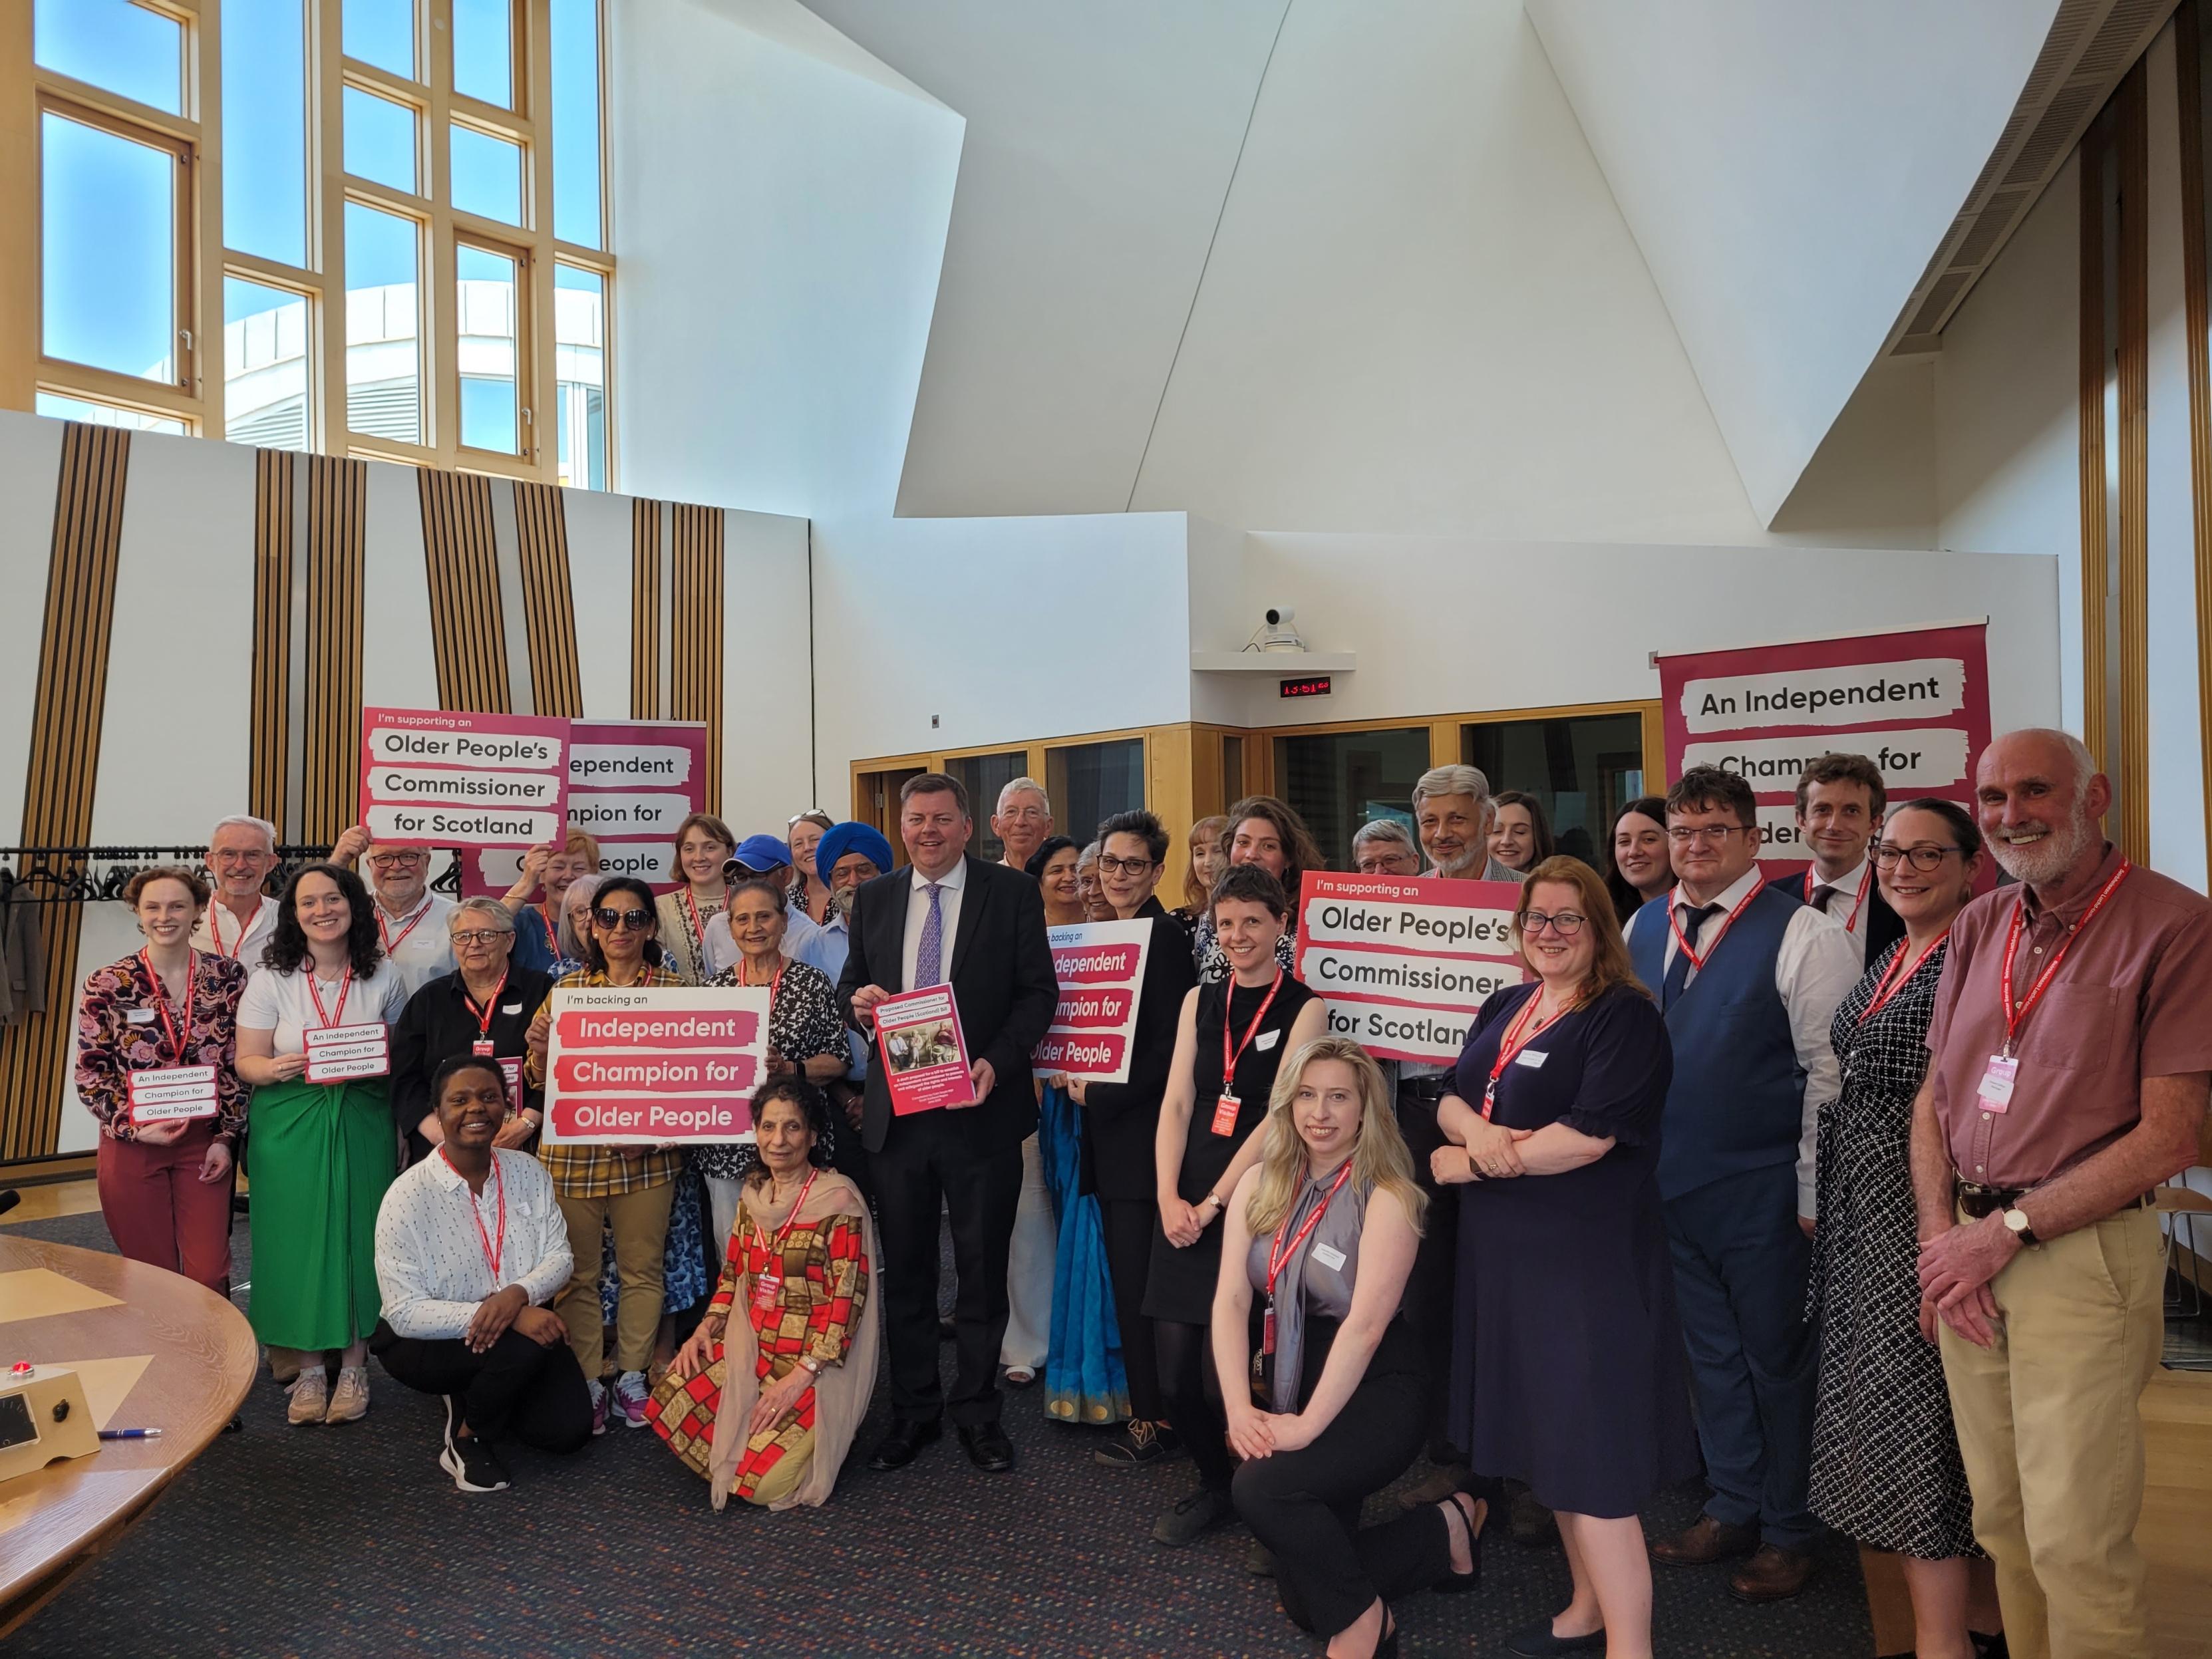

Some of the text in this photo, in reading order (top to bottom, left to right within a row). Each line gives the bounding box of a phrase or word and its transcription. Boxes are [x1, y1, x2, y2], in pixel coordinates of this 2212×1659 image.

[1700, 677, 1939, 716] An Independent
[378, 713, 395, 723] I'm
[397, 716, 455, 728] supporting
[385, 735, 548, 762] Older People's
[1878, 746, 1921, 771] for
[569, 756, 674, 776] ependent
[385, 774, 546, 797] Commissioner
[633, 804, 662, 821] for
[394, 814, 533, 835] for Scotland
[599, 853, 659, 875] eople
[1317, 879, 1418, 897] I'm supporting an
[1322, 906, 1509, 943] Older People's
[1051, 932, 1074, 943] backing
[1054, 951, 1126, 978] dependent
[1319, 957, 1503, 994] Commissioner
[567, 995, 583, 1004] I'm
[587, 995, 631, 1006] backing
[880, 1004, 903, 1013] Proposed
[905, 997, 937, 1008] Commissioner
[1056, 995, 1122, 1021] mpion for
[915, 1008, 939, 1017] (Scotland)
[326, 1029, 379, 1040] Independent
[580, 1017, 736, 1042] Independent
[1328, 1008, 1468, 1046] for Scotlan
[319, 1048, 362, 1058] Champion
[1066, 1040, 1112, 1068] People
[152, 1070, 208, 1081] Independent
[347, 1062, 375, 1071] People
[573, 1061, 739, 1086] Champion for
[1990, 1066, 2012, 1078] Group
[144, 1089, 190, 1099] Champion
[174, 1104, 203, 1114] People
[574, 1105, 732, 1131] Older People
